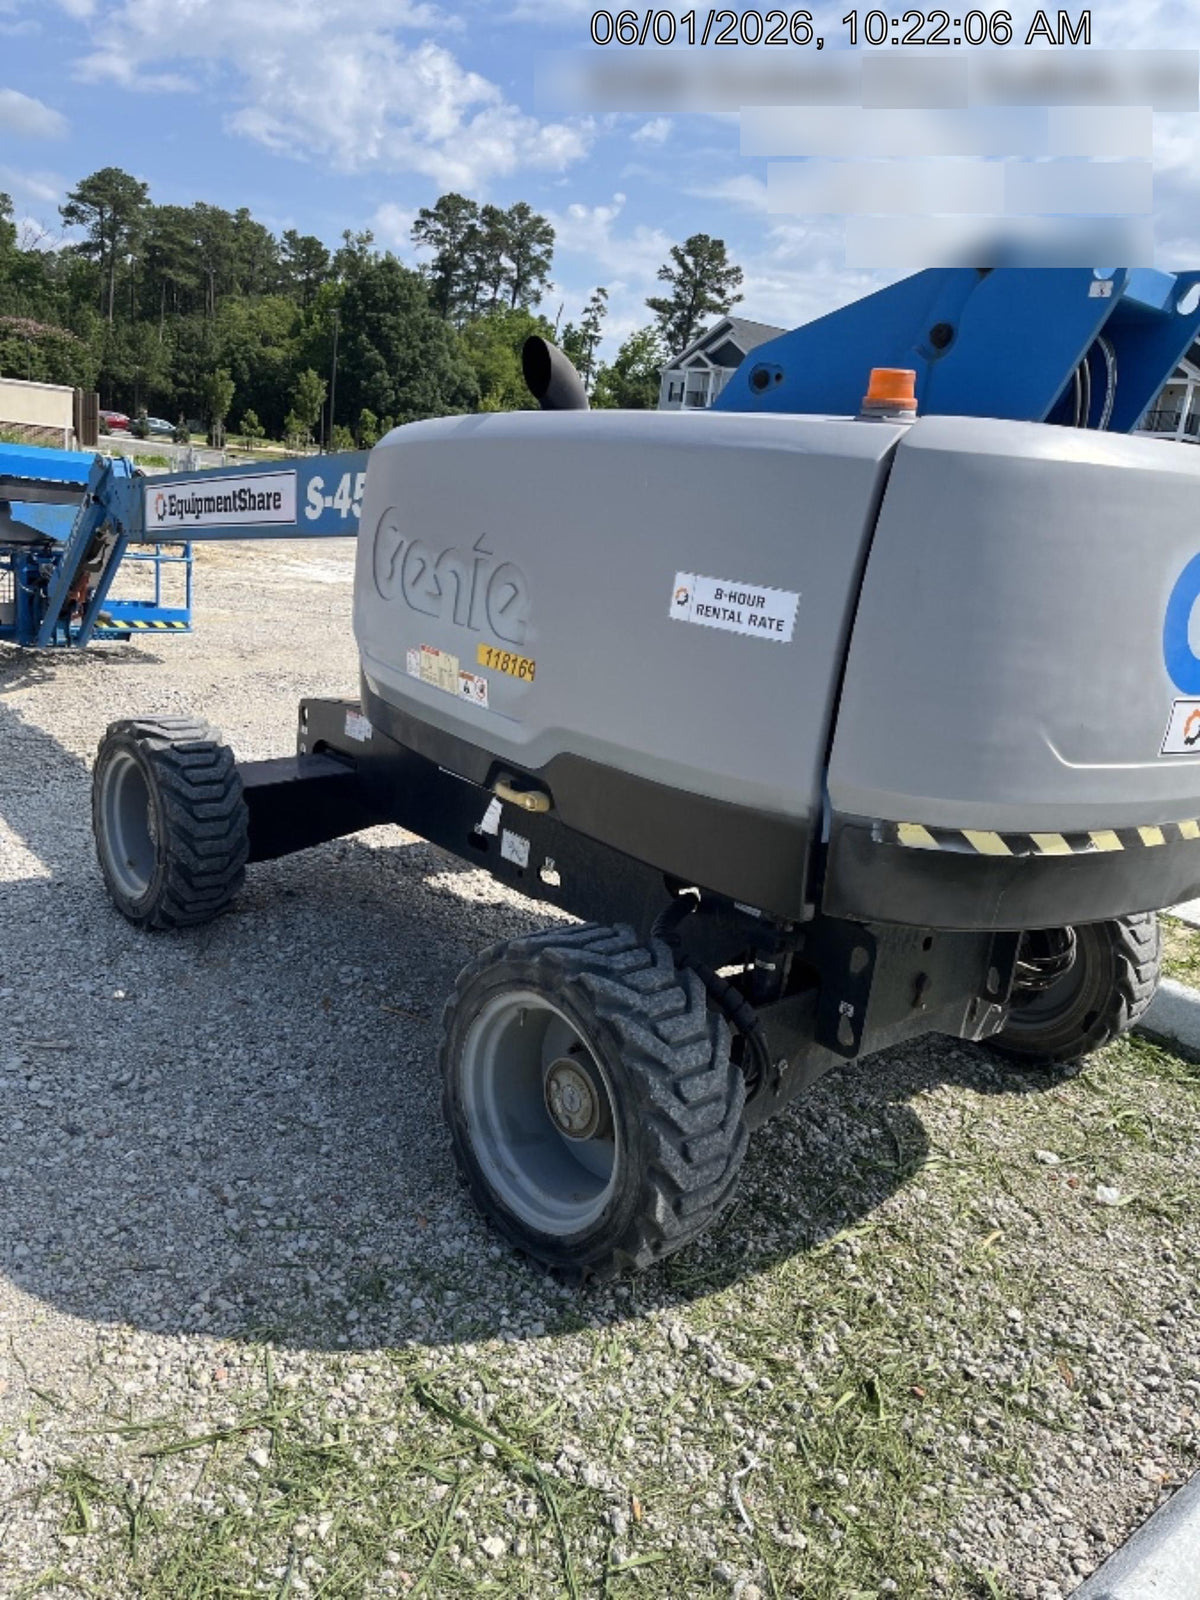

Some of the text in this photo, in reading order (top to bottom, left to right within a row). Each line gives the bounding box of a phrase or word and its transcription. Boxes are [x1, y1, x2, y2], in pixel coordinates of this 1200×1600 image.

[168, 488, 282, 520] EquipmentShare
[373, 506, 528, 646] Genie
[714, 588, 766, 609] 8-HOUR
[696, 604, 785, 632] RENTAL RATE
[486, 648, 536, 682] 118169
